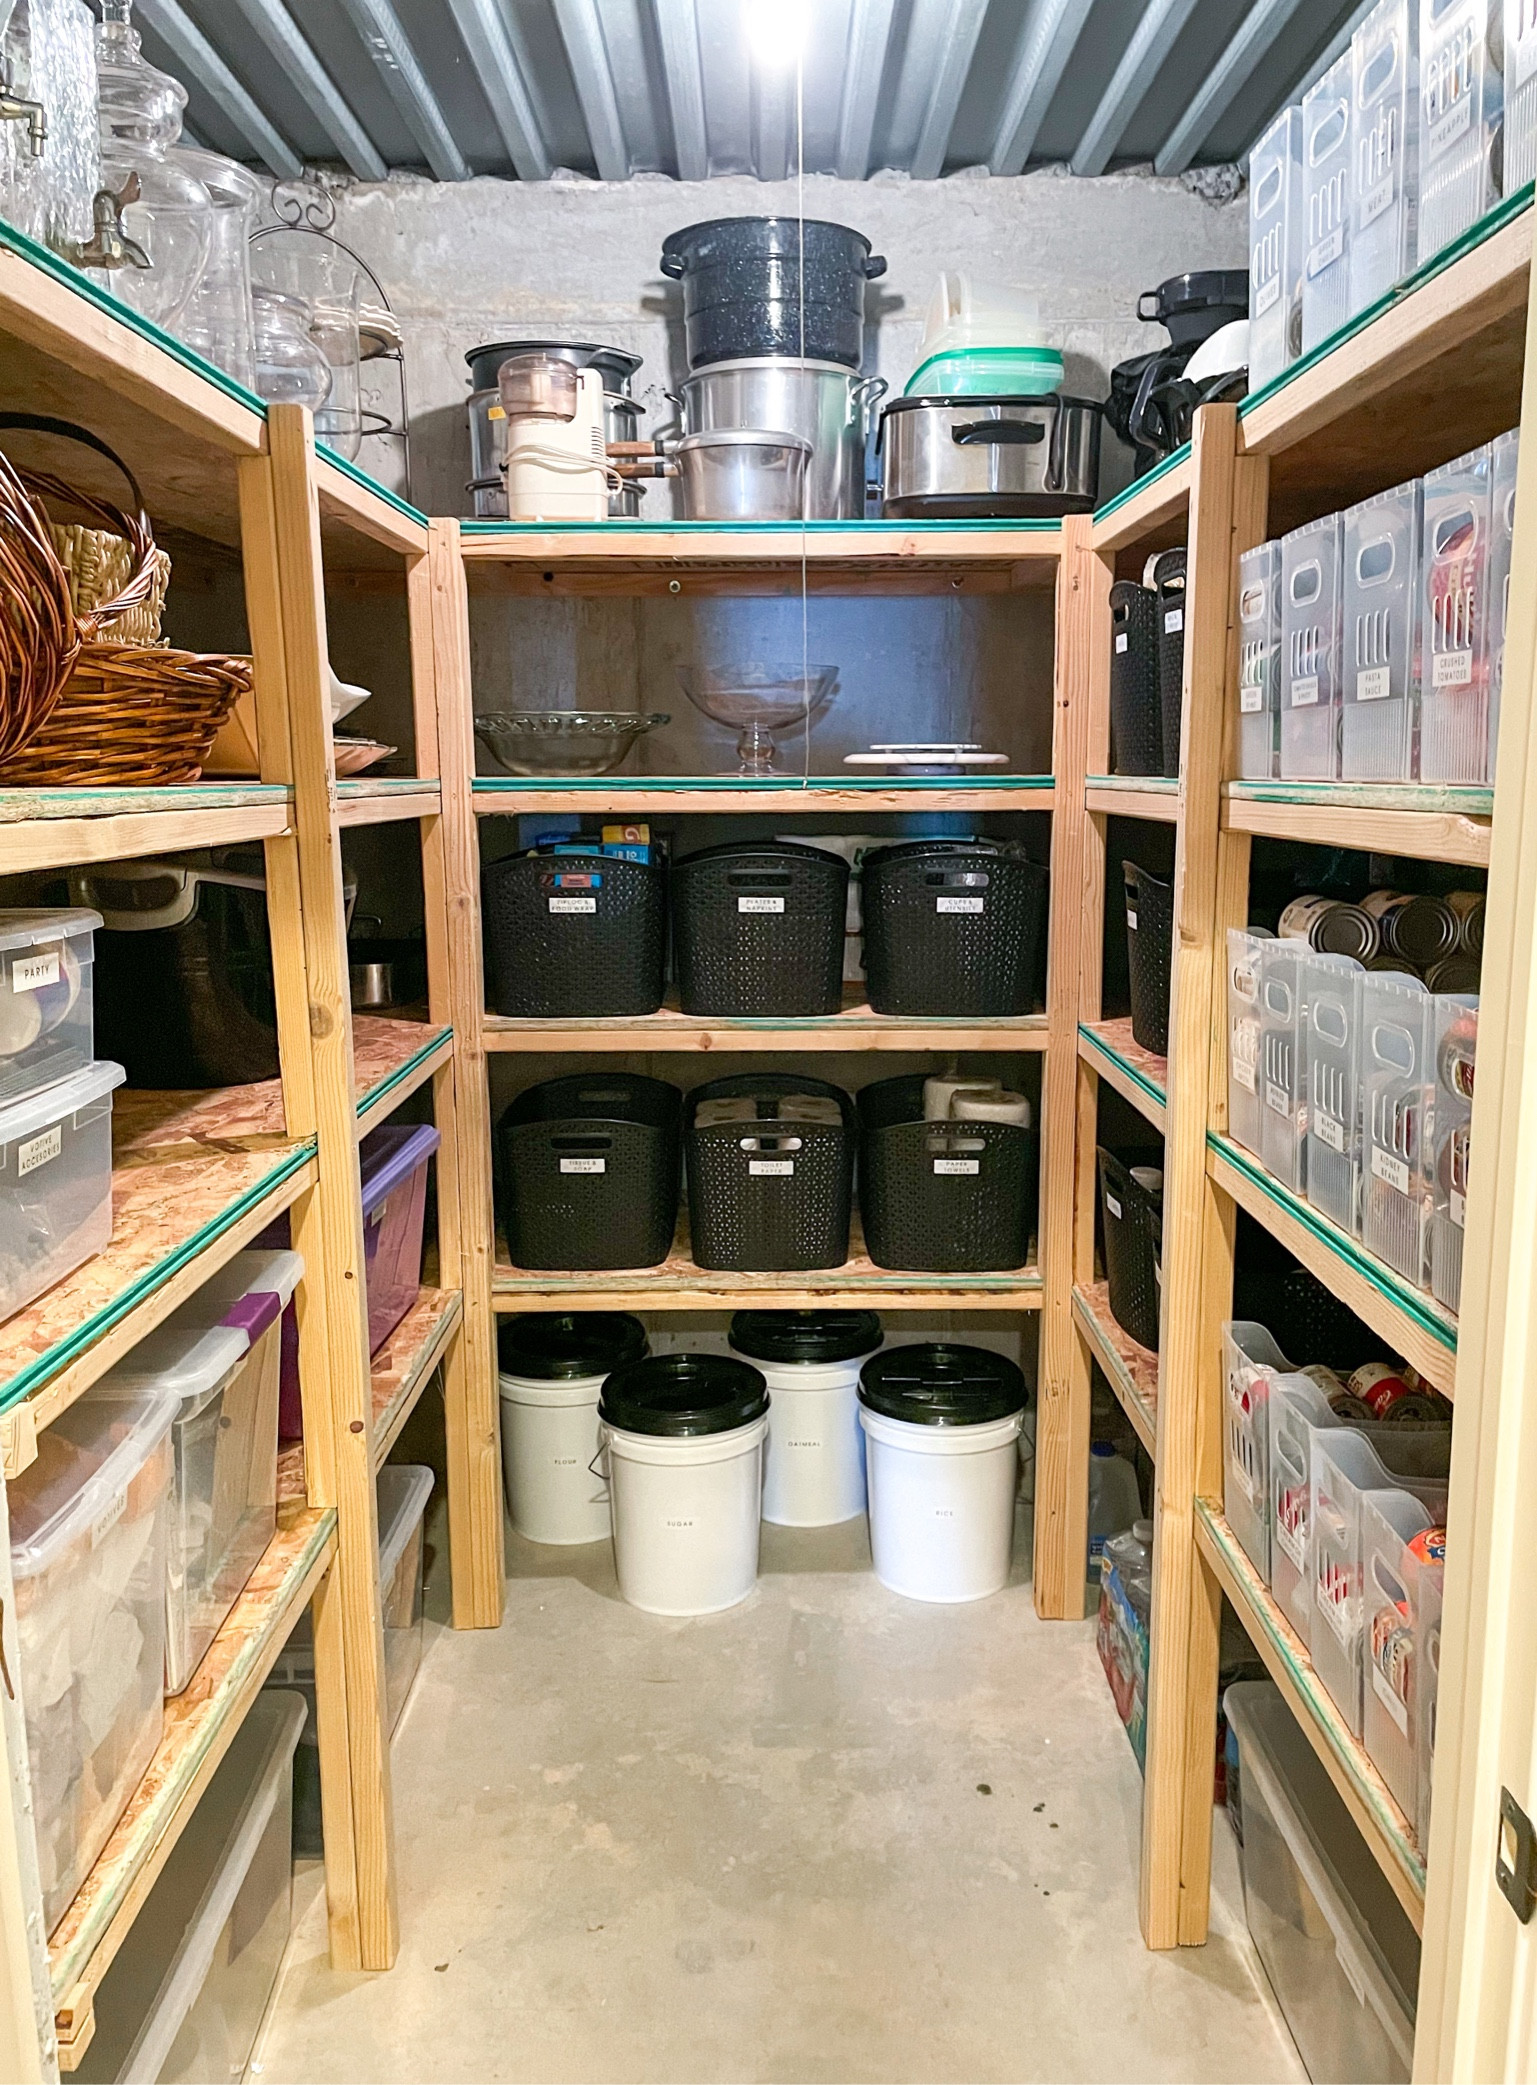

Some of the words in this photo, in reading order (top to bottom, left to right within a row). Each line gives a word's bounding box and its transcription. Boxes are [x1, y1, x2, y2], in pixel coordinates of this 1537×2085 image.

[1439, 655, 1465, 669] CRUSHED
[1365, 672, 1381, 683] PASTA
[1437, 669, 1467, 683] TOMATOES
[1365, 685, 1381, 697] SAUCE
[24, 964, 50, 980] PARTY
[1321, 1116, 1336, 1134] BLACK
[30, 1134, 52, 1153] VOTIVE
[1321, 1128, 1336, 1145] BEANS
[1380, 1154, 1400, 1174] KIDNEY
[1381, 1167, 1399, 1186] BEANS
